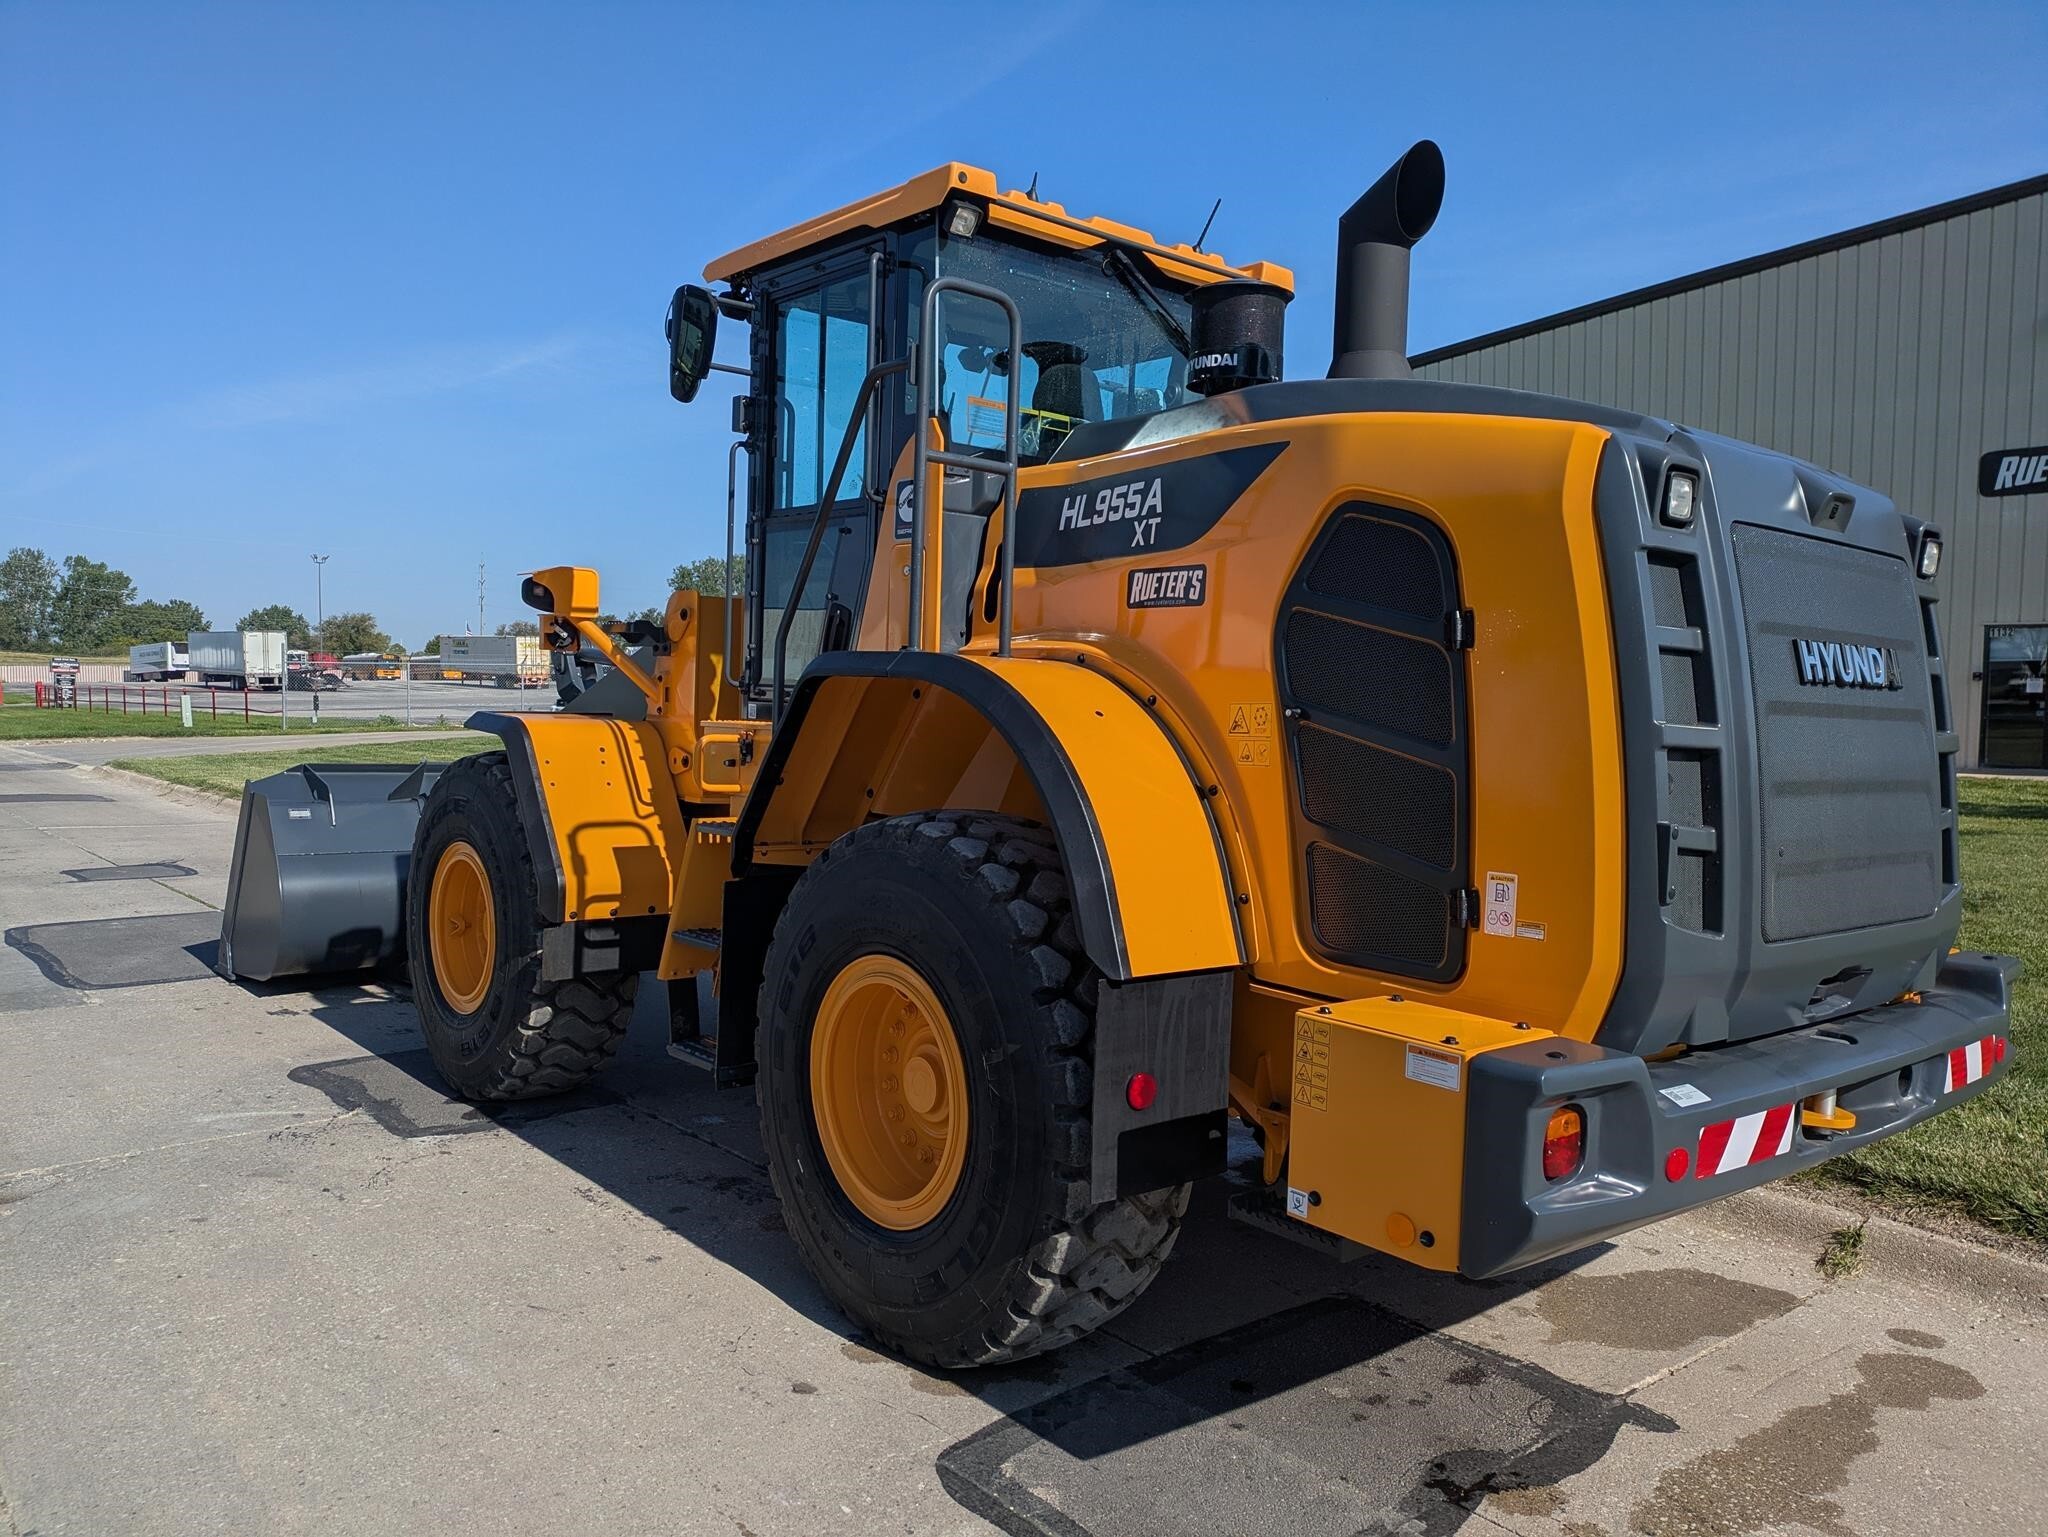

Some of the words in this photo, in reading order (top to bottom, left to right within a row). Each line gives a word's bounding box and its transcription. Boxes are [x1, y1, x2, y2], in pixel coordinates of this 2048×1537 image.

[1190, 353, 1238, 371] YUNDAI
[1059, 477, 1162, 531] HL955A
[1131, 517, 1161, 548] XT
[1130, 569, 1203, 604] RUETER'S
